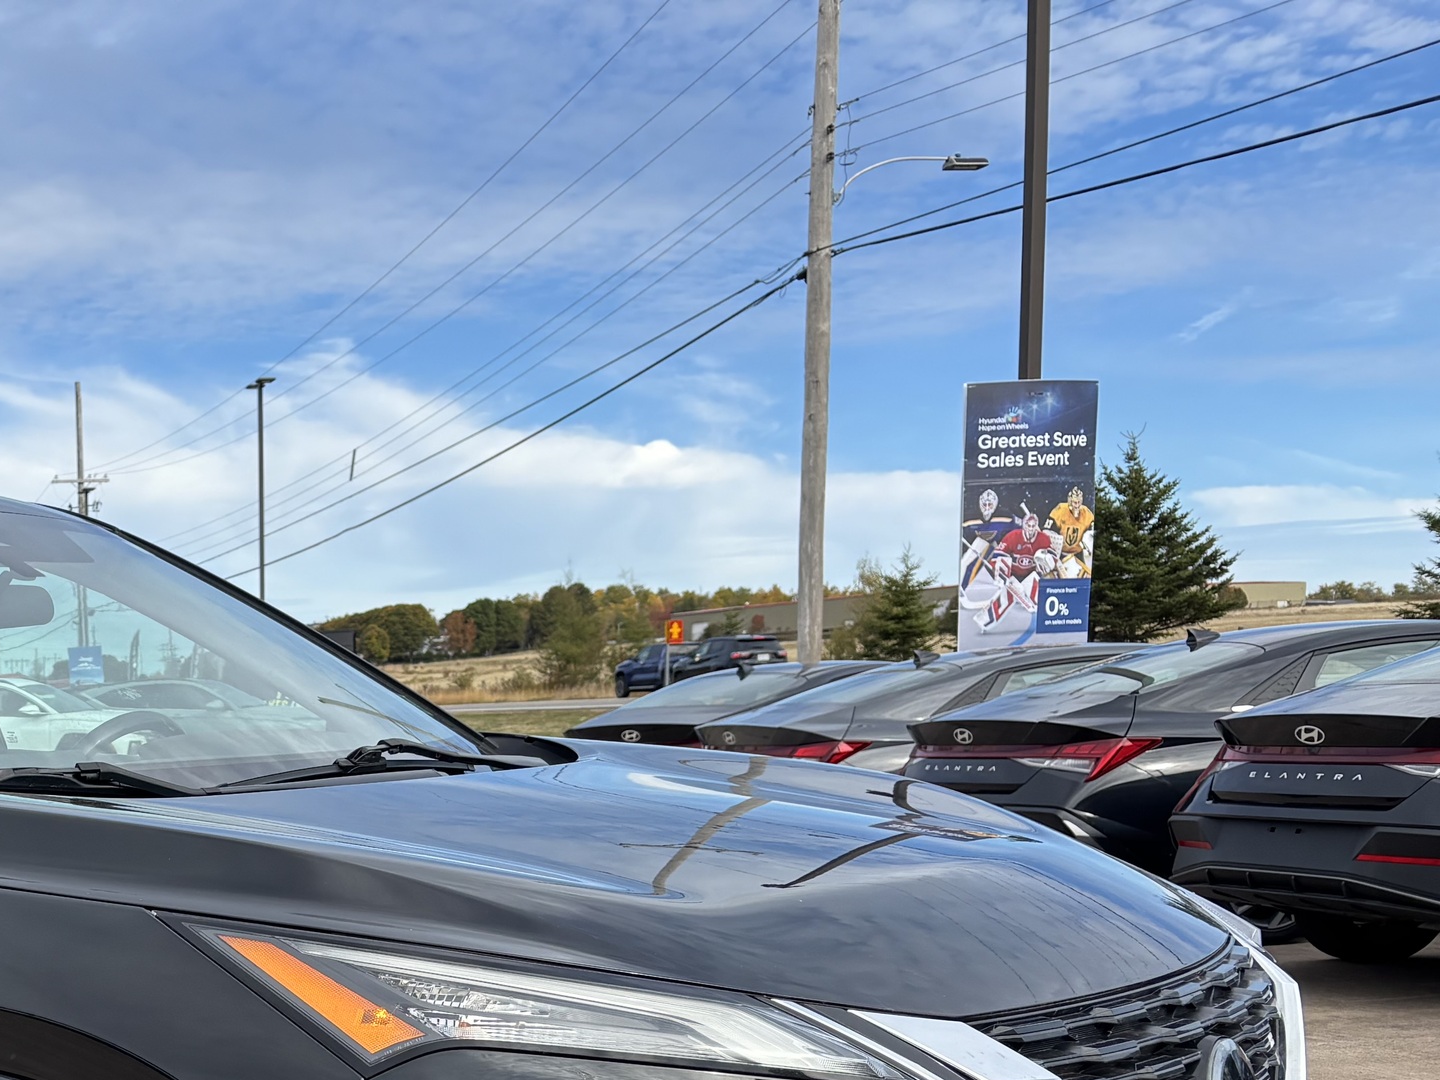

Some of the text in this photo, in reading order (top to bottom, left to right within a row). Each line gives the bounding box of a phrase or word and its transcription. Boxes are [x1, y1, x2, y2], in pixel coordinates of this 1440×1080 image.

[978, 424, 996, 432] Hope
[1006, 422, 1029, 430] Wheels
[977, 431, 1088, 450] Greatest Save
[976, 450, 1070, 468] Sales Event
[1045, 596, 1069, 616] 0%
[924, 764, 996, 772] ELANTRA
[1248, 771, 1362, 782] ELANTRA
